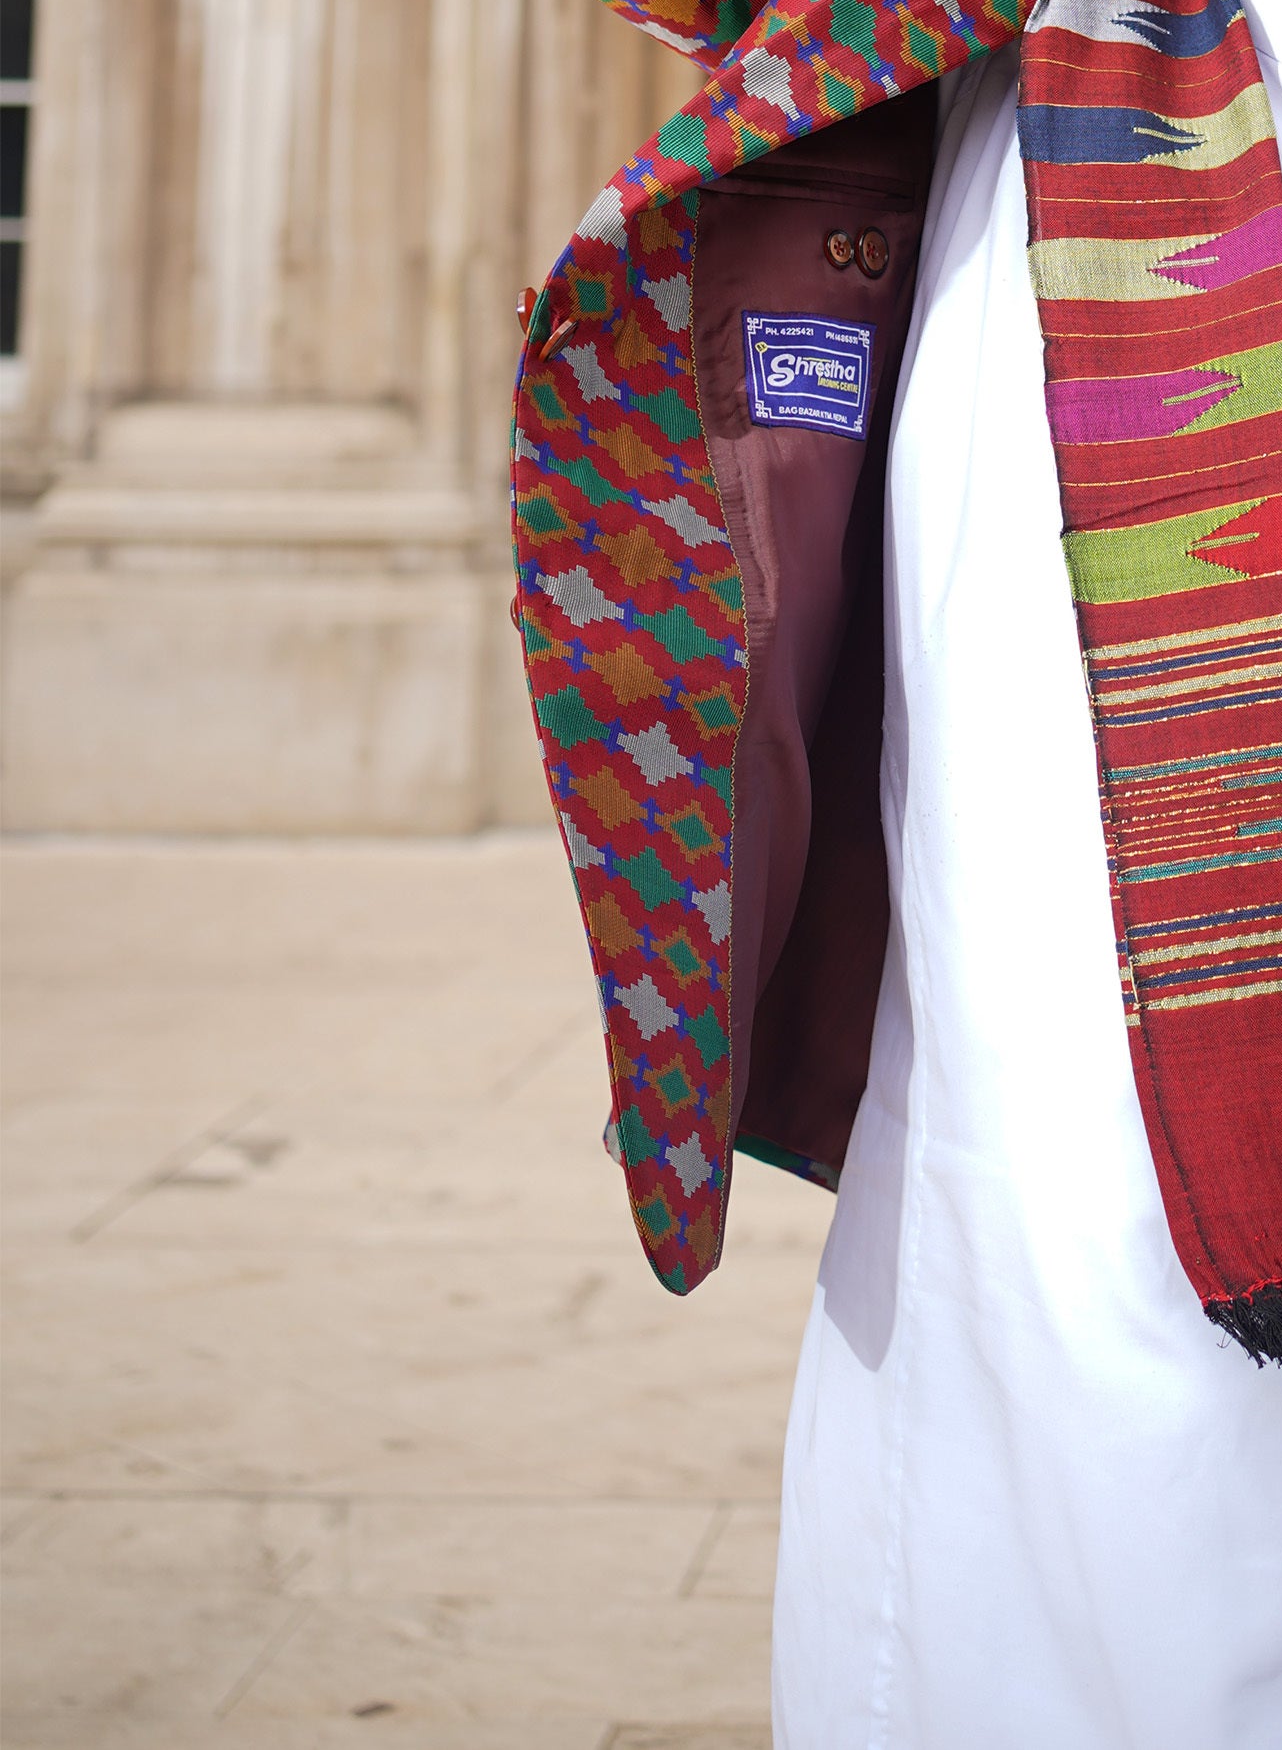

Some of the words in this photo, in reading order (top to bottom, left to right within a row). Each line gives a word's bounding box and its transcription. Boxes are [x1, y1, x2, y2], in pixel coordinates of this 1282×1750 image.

[767, 353, 856, 387] Shrestha
[778, 406, 798, 415] BAG
[798, 407, 820, 418] BAZAR
